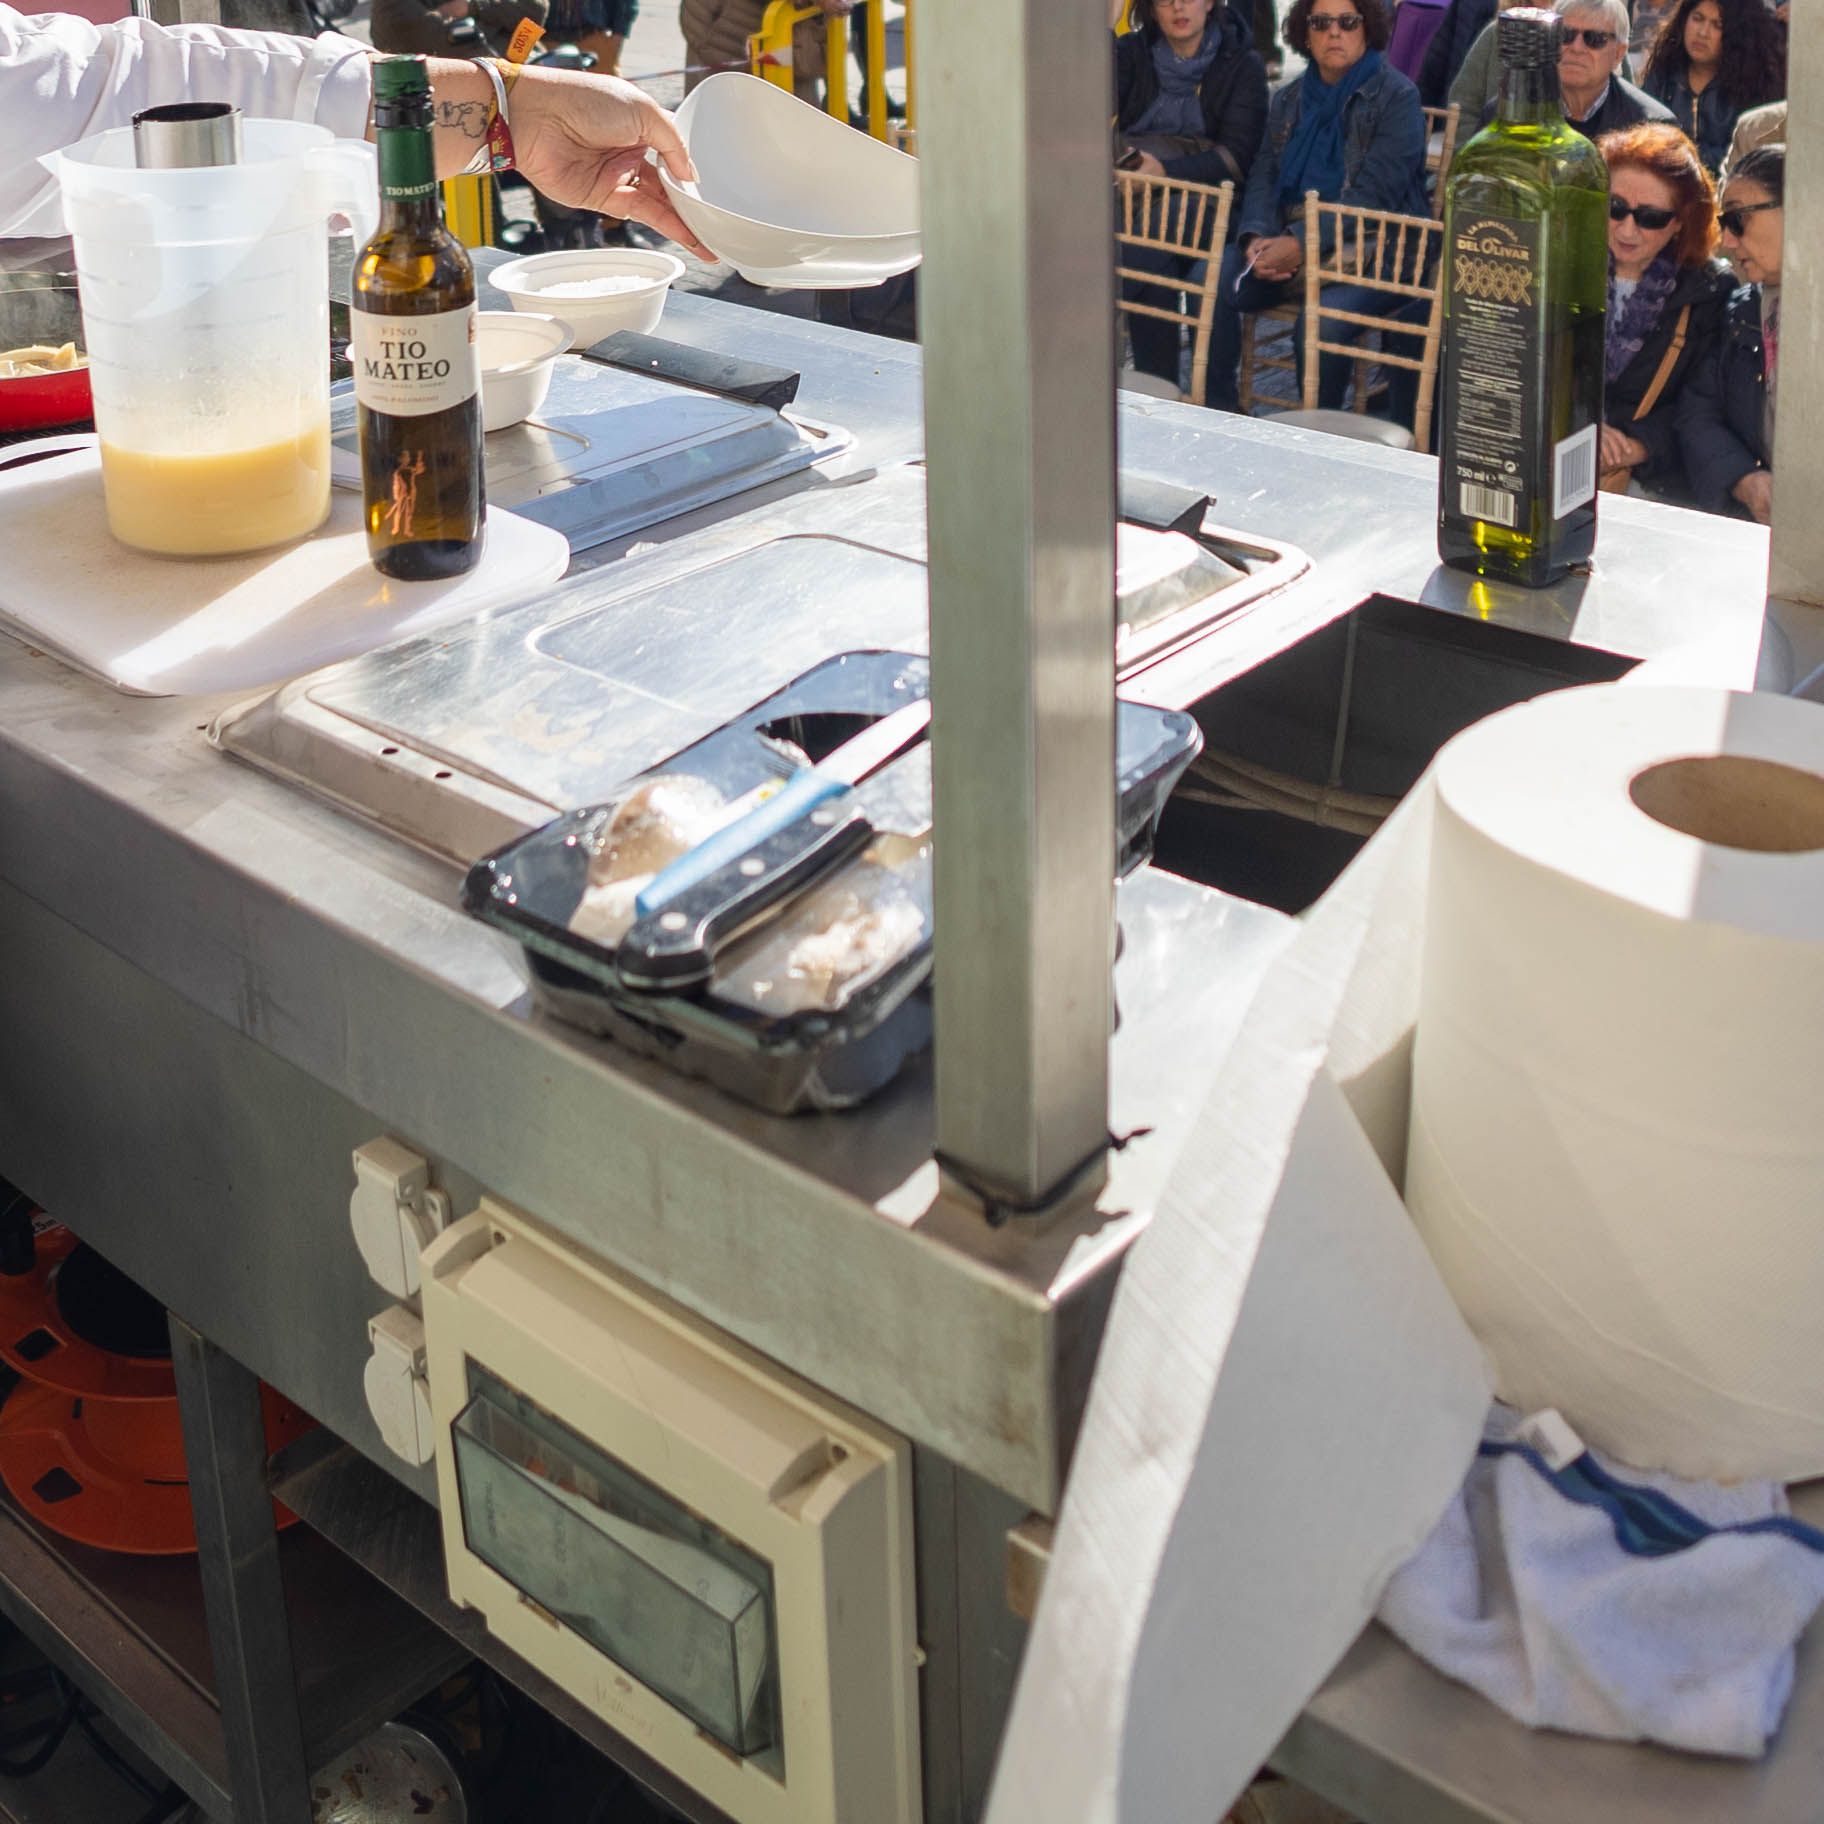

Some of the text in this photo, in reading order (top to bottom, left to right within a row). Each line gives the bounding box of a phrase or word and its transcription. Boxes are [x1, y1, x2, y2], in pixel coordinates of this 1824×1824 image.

[1456, 237, 1530, 261] DEL OLIVAR
[381, 327, 418, 338] FINO
[380, 341, 427, 360] TIO
[364, 358, 451, 381] MATEO
[1456, 465, 1473, 479] 750
